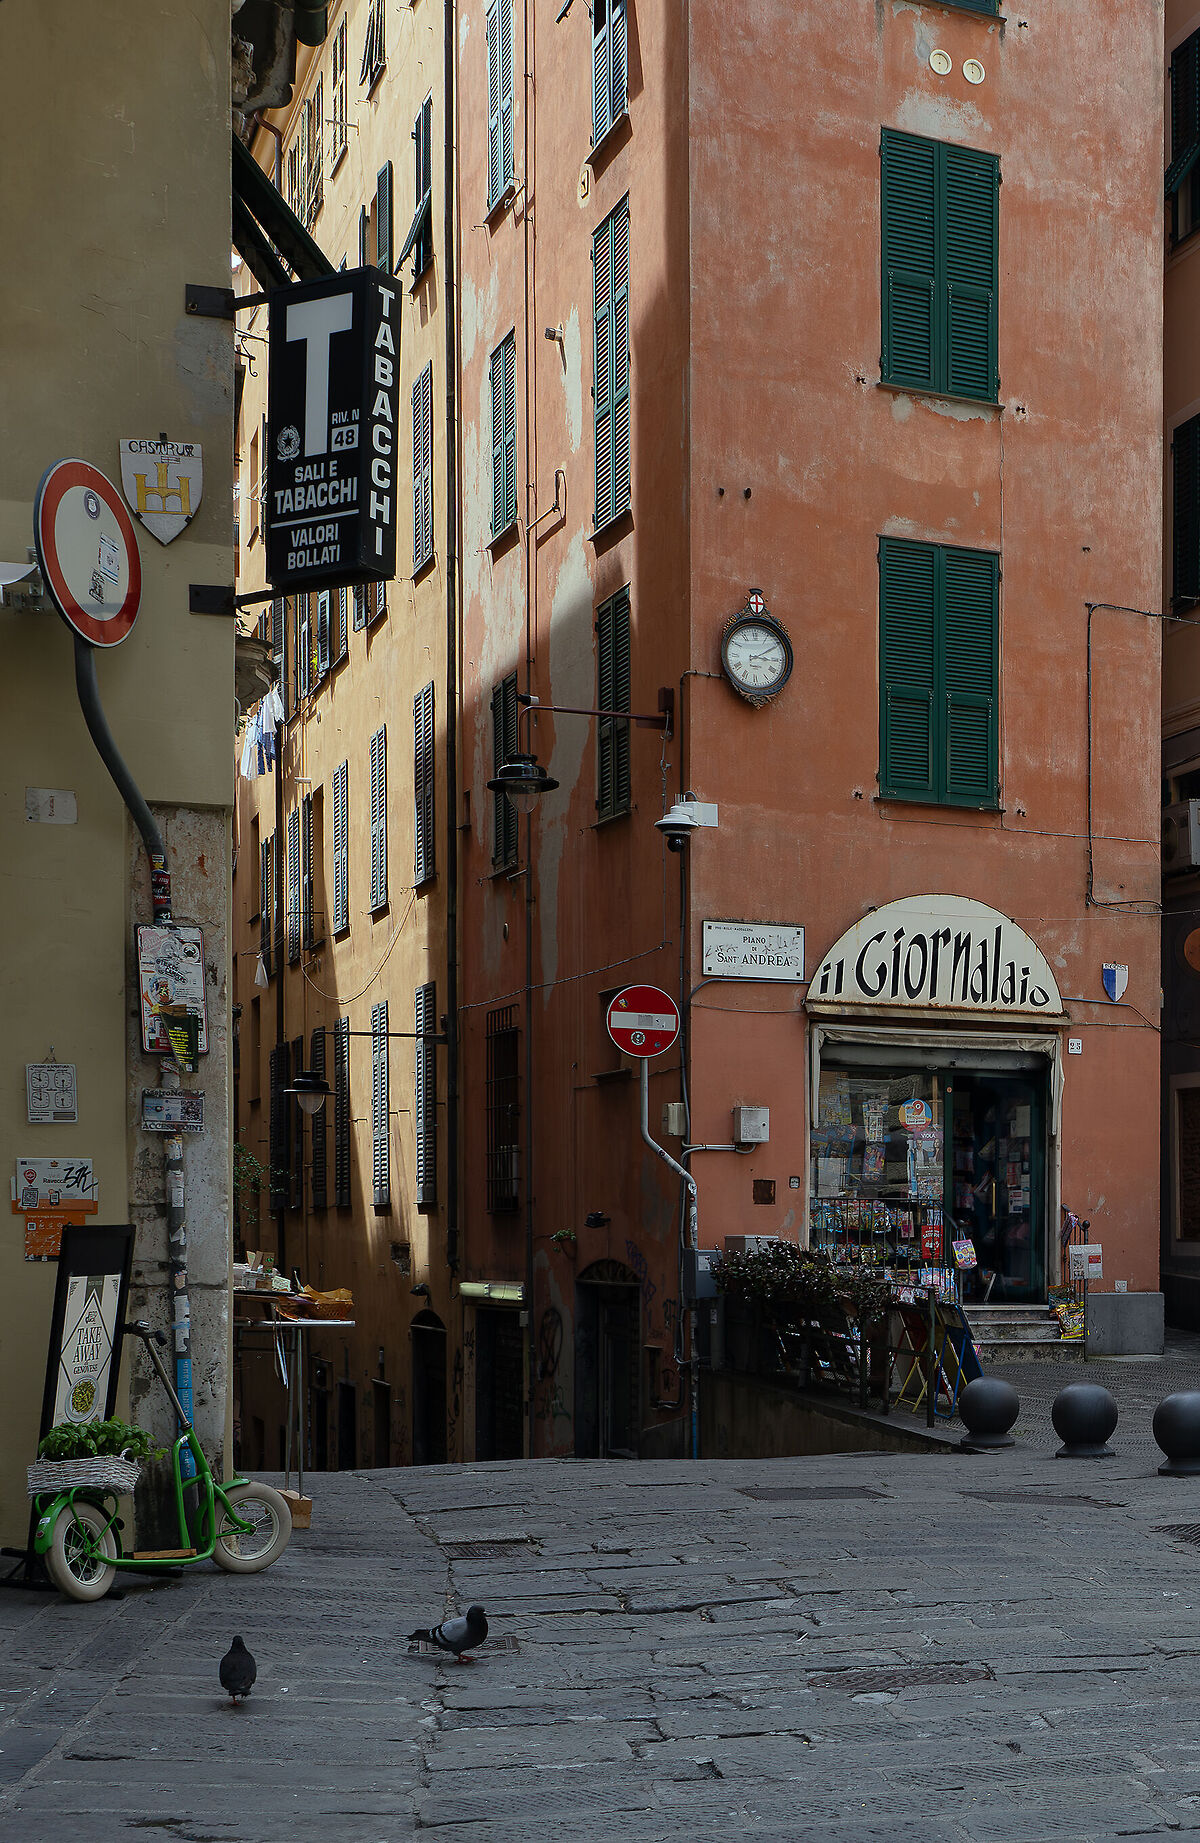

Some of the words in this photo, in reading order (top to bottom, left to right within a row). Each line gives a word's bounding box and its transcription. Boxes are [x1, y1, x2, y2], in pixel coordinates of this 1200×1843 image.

[286, 292, 353, 457] T
[331, 411, 349, 425] RIV.
[368, 285, 397, 557] TABACCHI
[334, 428, 355, 447] 48
[295, 462, 324, 483] SALI
[329, 460, 338, 477] E
[274, 477, 358, 514] TABACCHI
[291, 523, 339, 547] VALORI
[287, 544, 340, 570] BOLLATI
[742, 936, 766, 944] PIANO
[820, 958, 845, 996] il
[855, 924, 1051, 1008] Giornalaio
[77, 1326, 102, 1345] TAKE
[72, 1343, 102, 1363] AWAY
